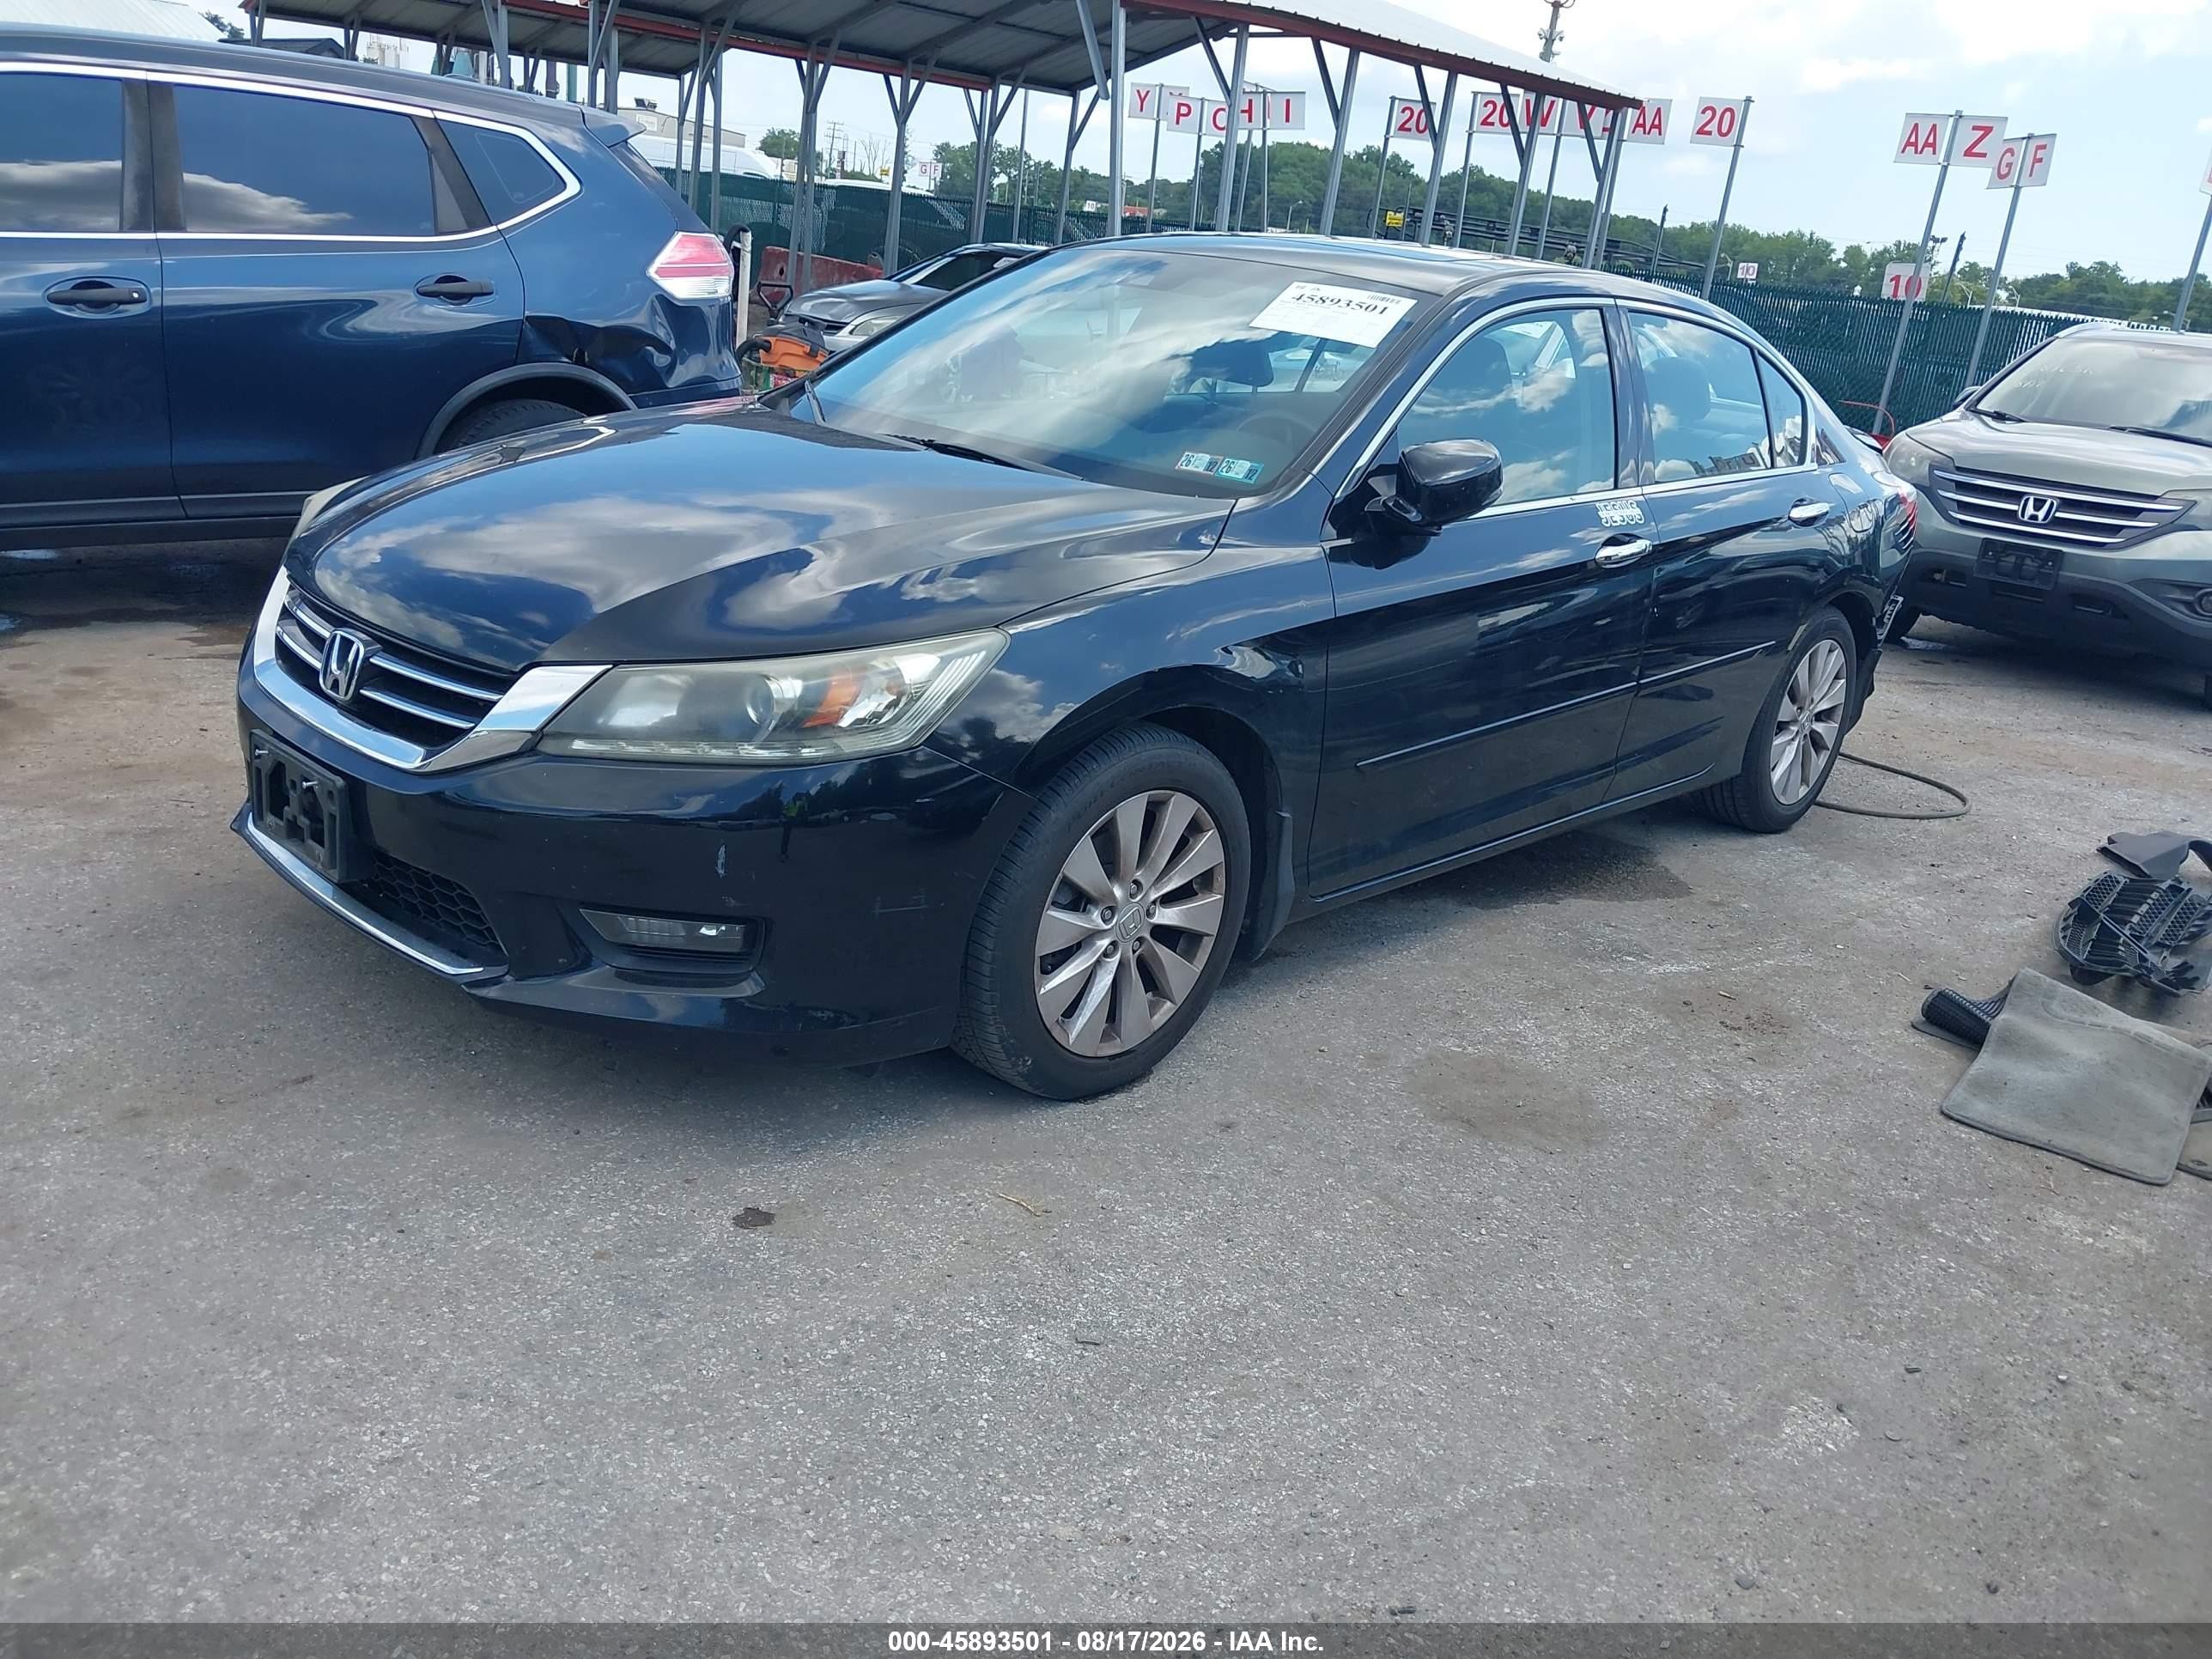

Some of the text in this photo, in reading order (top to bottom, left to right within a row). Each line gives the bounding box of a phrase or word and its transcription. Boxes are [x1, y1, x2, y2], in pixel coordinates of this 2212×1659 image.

[1135, 88, 1151, 112] Y
[1175, 101, 1192, 125] P
[1397, 106, 1428, 134] 20
[1480, 100, 1511, 128] 20
[1632, 105, 1662, 137] AA
[1695, 105, 1735, 137] 20
[1900, 122, 1994, 158] AA Z
[921, 164, 939, 174] G F
[1996, 143, 2048, 179] G F
[1739, 264, 1756, 276] 10
[1888, 274, 1923, 299] 10
[1291, 293, 1389, 315] 45893501
[1180, 453, 1194, 467] 26
[1219, 459, 1235, 474] 26
